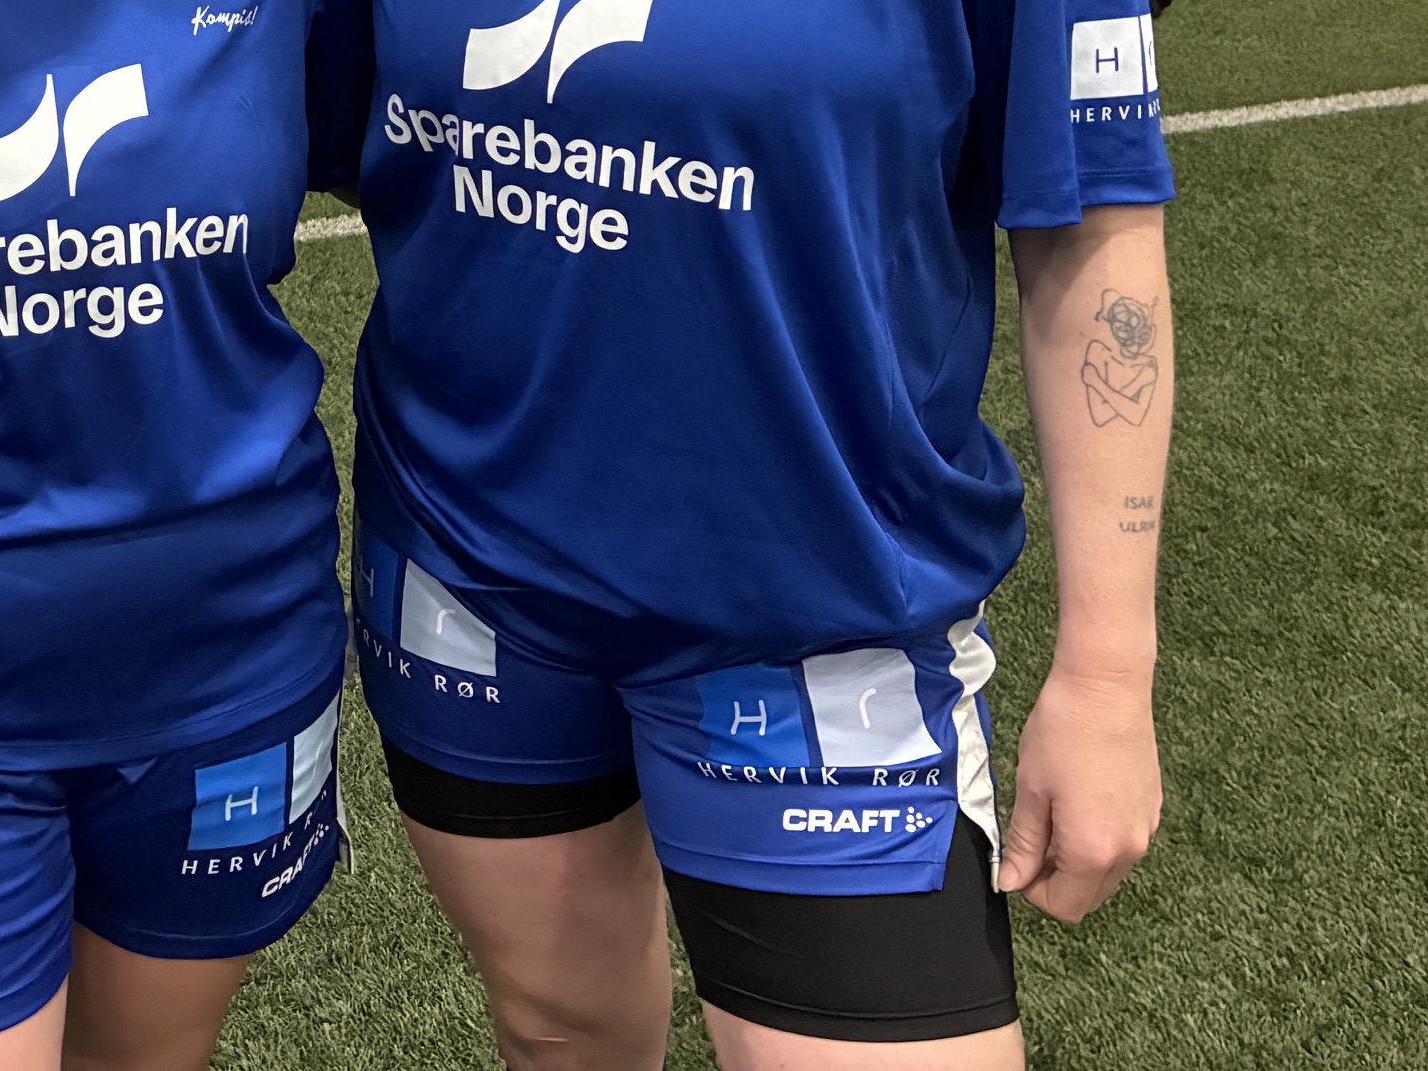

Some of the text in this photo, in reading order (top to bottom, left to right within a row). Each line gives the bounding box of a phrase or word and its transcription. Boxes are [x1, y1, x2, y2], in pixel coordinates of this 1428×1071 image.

[191, 5, 258, 36] Kompis!
[1095, 47, 1120, 73] H
[384, 94, 755, 211] Sparebanken
[453, 164, 629, 254] Norge
[434, 674, 501, 704] RØR
[730, 699, 767, 736] H
[697, 761, 941, 788] HERVIK RØR
[225, 786, 259, 821] H
[782, 808, 901, 833] CRAFT
[181, 831, 294, 875] HERVIK
